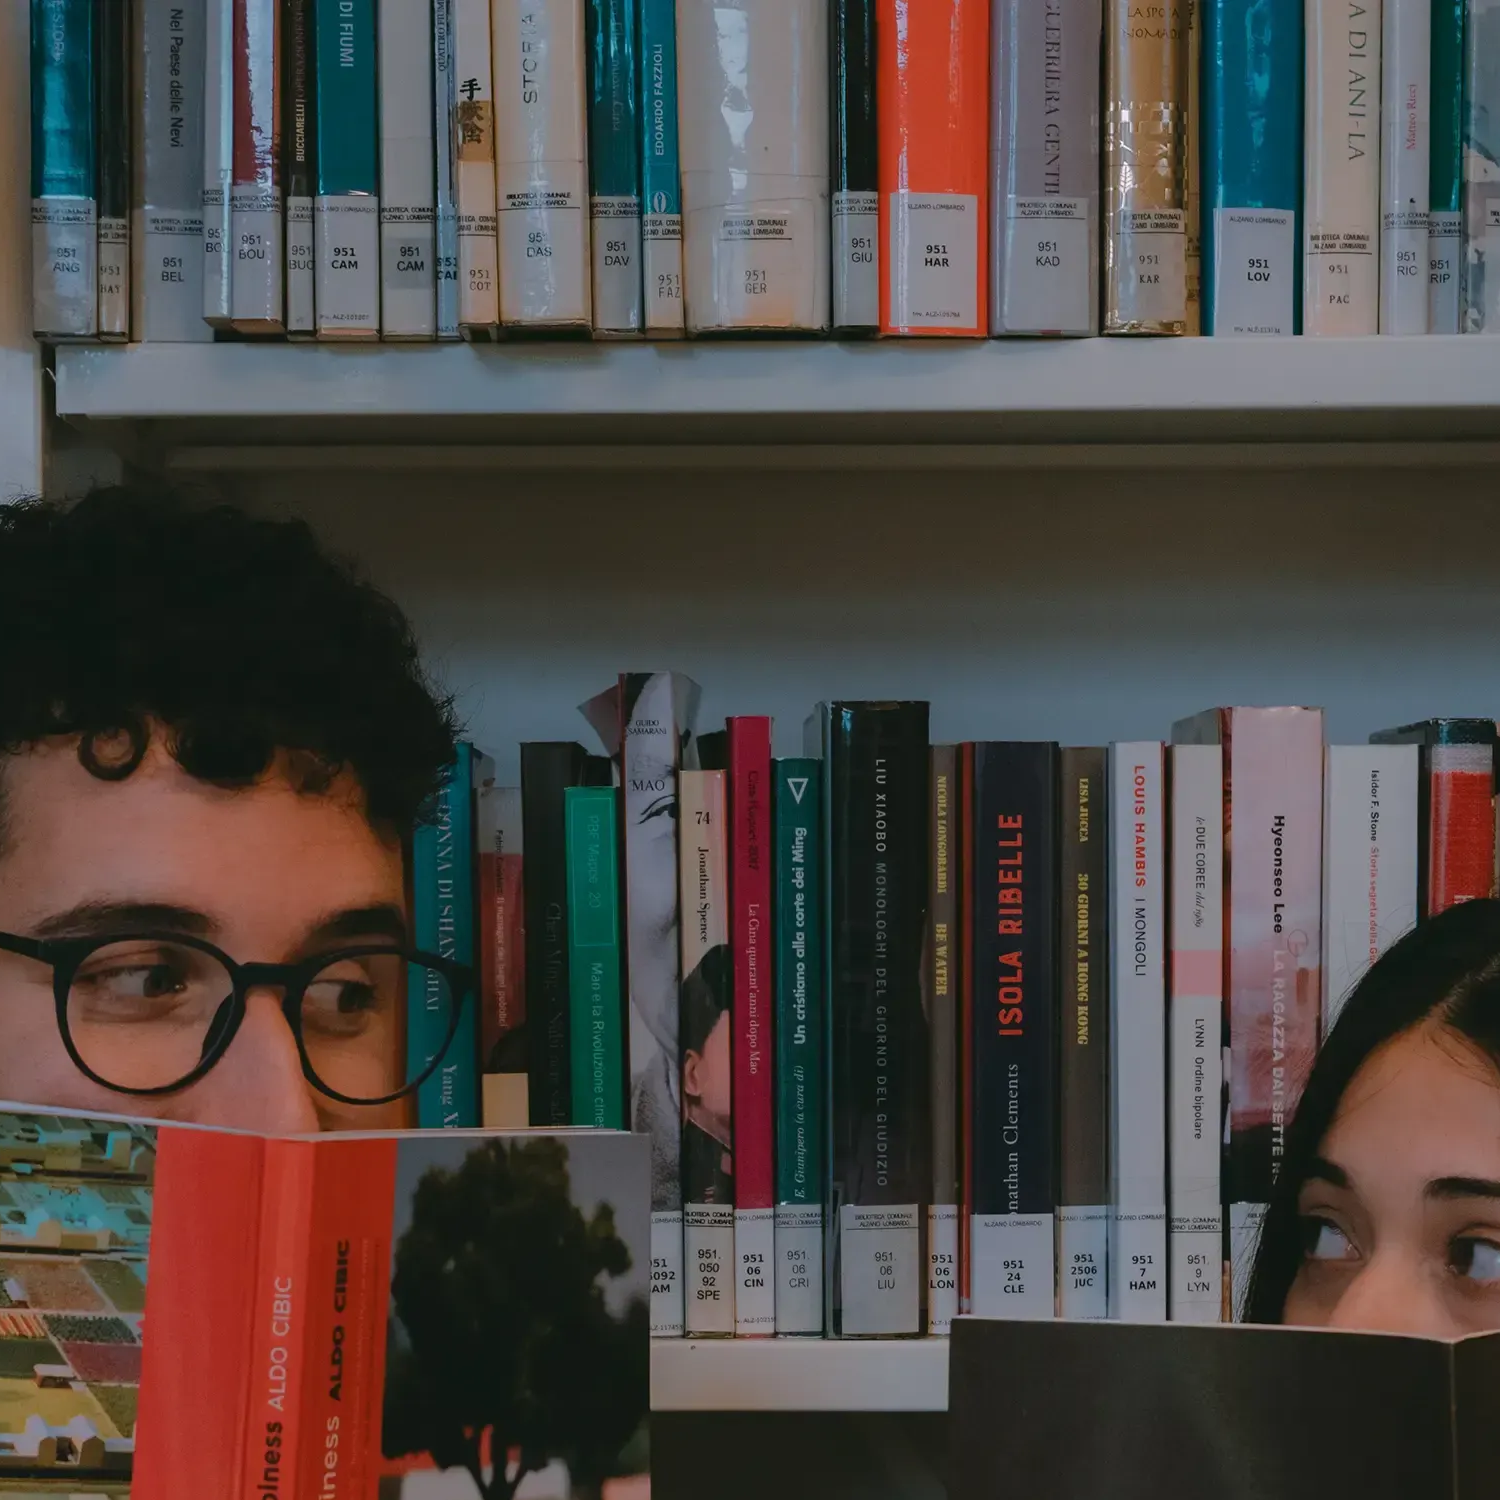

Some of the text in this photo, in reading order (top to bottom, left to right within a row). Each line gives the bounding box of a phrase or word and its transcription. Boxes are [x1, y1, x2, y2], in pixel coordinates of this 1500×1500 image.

[169, 8, 183, 147] Nel Paese delle Nevi
[655, 44, 664, 156] EDOARDO FAZZIOLI
[331, 259, 358, 270] CAM
[333, 247, 356, 257] 951
[924, 255, 950, 269] HAR
[925, 244, 948, 257] 951
[631, 777, 666, 793] MAO
[1133, 765, 1146, 816] LOUIS
[694, 811, 712, 825] 74
[1134, 822, 1146, 888] HAMBIS
[696, 846, 711, 943] Jonathan Spence
[997, 814, 1024, 1036] ISOLA RIBELLE
[1134, 907, 1146, 976] MONGOLI
[875, 758, 888, 1187] LIU XIAOBO MONOLOGHI DEL GIORNO DEL GIUDIZIO
[333, 1240, 350, 1313] CIBIC
[1002, 1259, 1025, 1270] 951
[1003, 1283, 1025, 1294] CLE
[1005, 1271, 1022, 1281] 24
[272, 1275, 292, 1336] CIBIC
[268, 1347, 289, 1411] ALDO
[328, 1325, 346, 1403] ALDO
